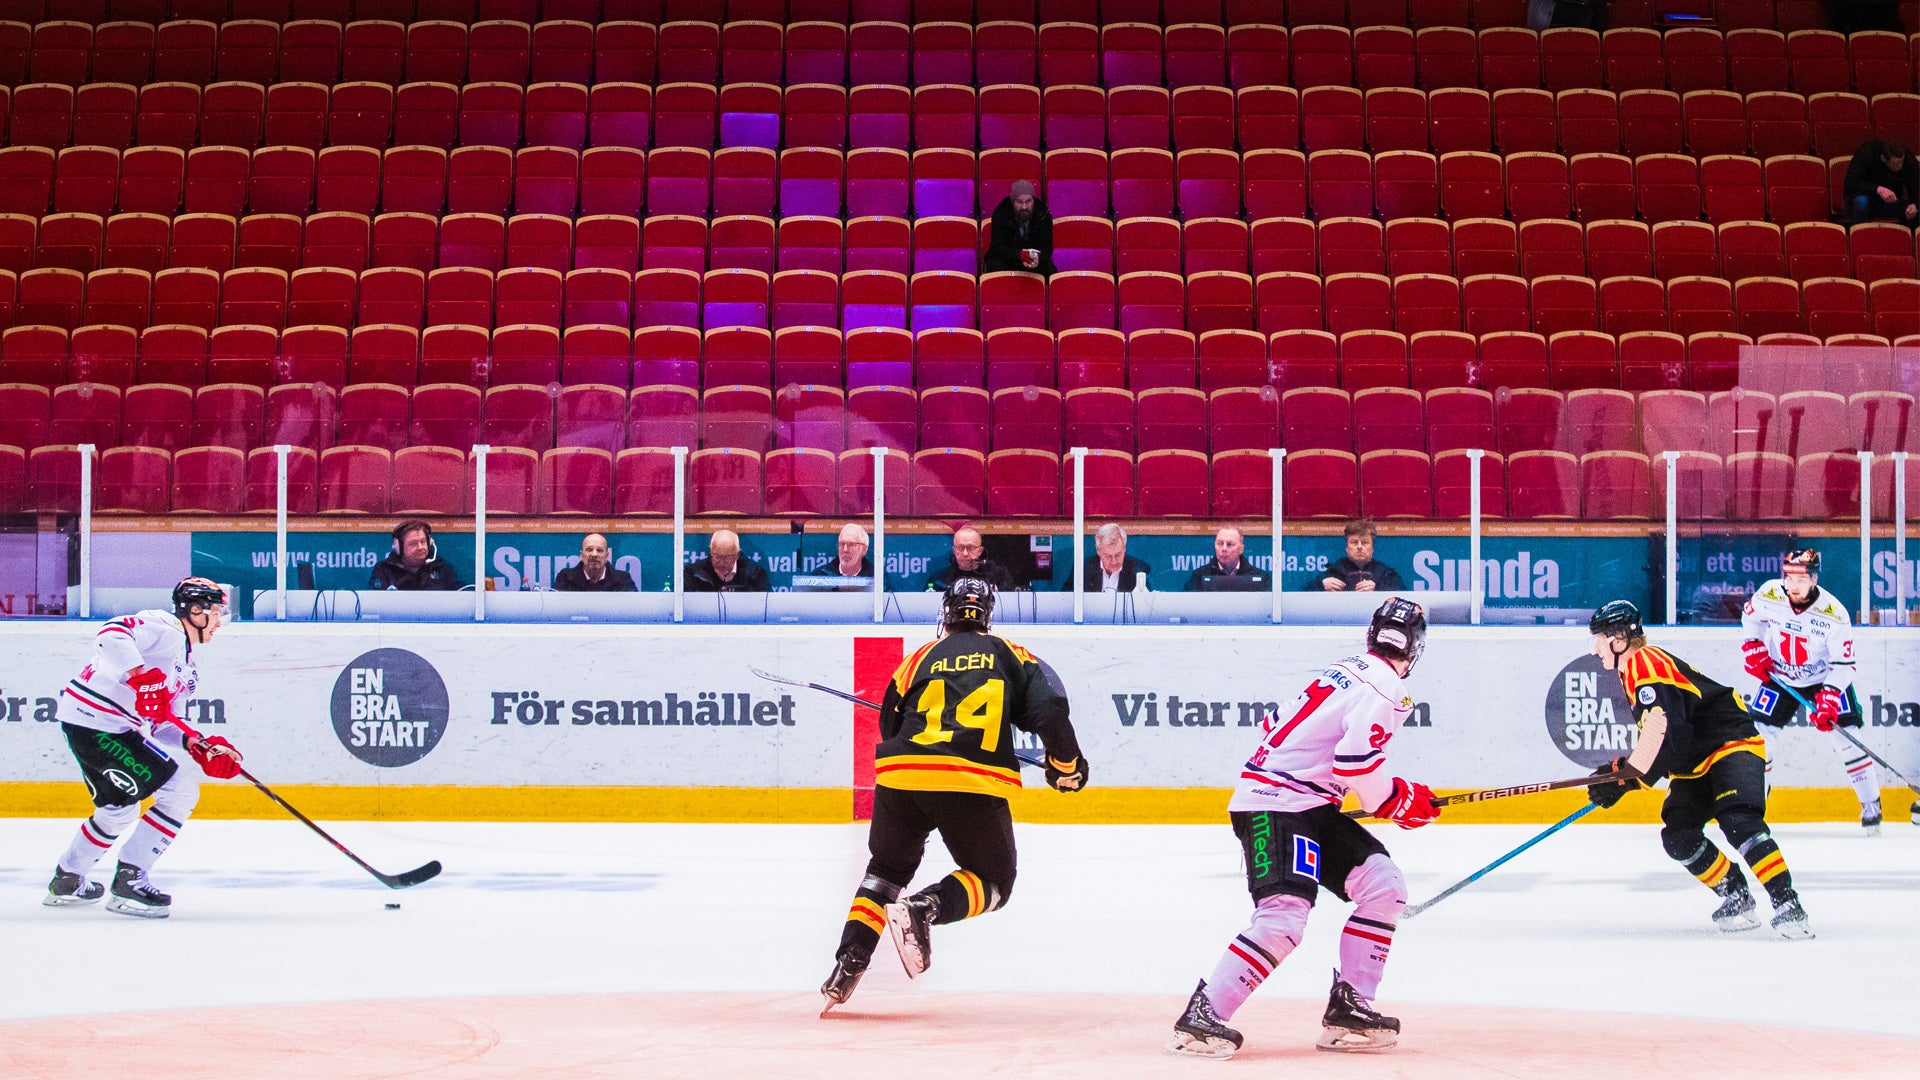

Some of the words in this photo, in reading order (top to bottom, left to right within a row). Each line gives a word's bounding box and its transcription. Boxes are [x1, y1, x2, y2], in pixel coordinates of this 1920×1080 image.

[768, 551, 797, 573] val
[883, 552, 931, 578] äljer
[1413, 550, 1560, 599] Sunda
[1706, 552, 1735, 573] ett
[963, 609, 978, 620] 14
[930, 652, 995, 674] ALCÉN
[350, 668, 384, 694] EN
[1565, 672, 1598, 698] EN
[350, 694, 402, 721] BRA
[490, 691, 565, 726] För
[571, 691, 797, 726] samhället
[909, 678, 1005, 753] 14
[1112, 692, 1160, 727] Vi
[1166, 696, 1230, 727] tar
[1565, 698, 1617, 724] BRA
[350, 721, 430, 747] START
[1565, 724, 1641, 750] START
